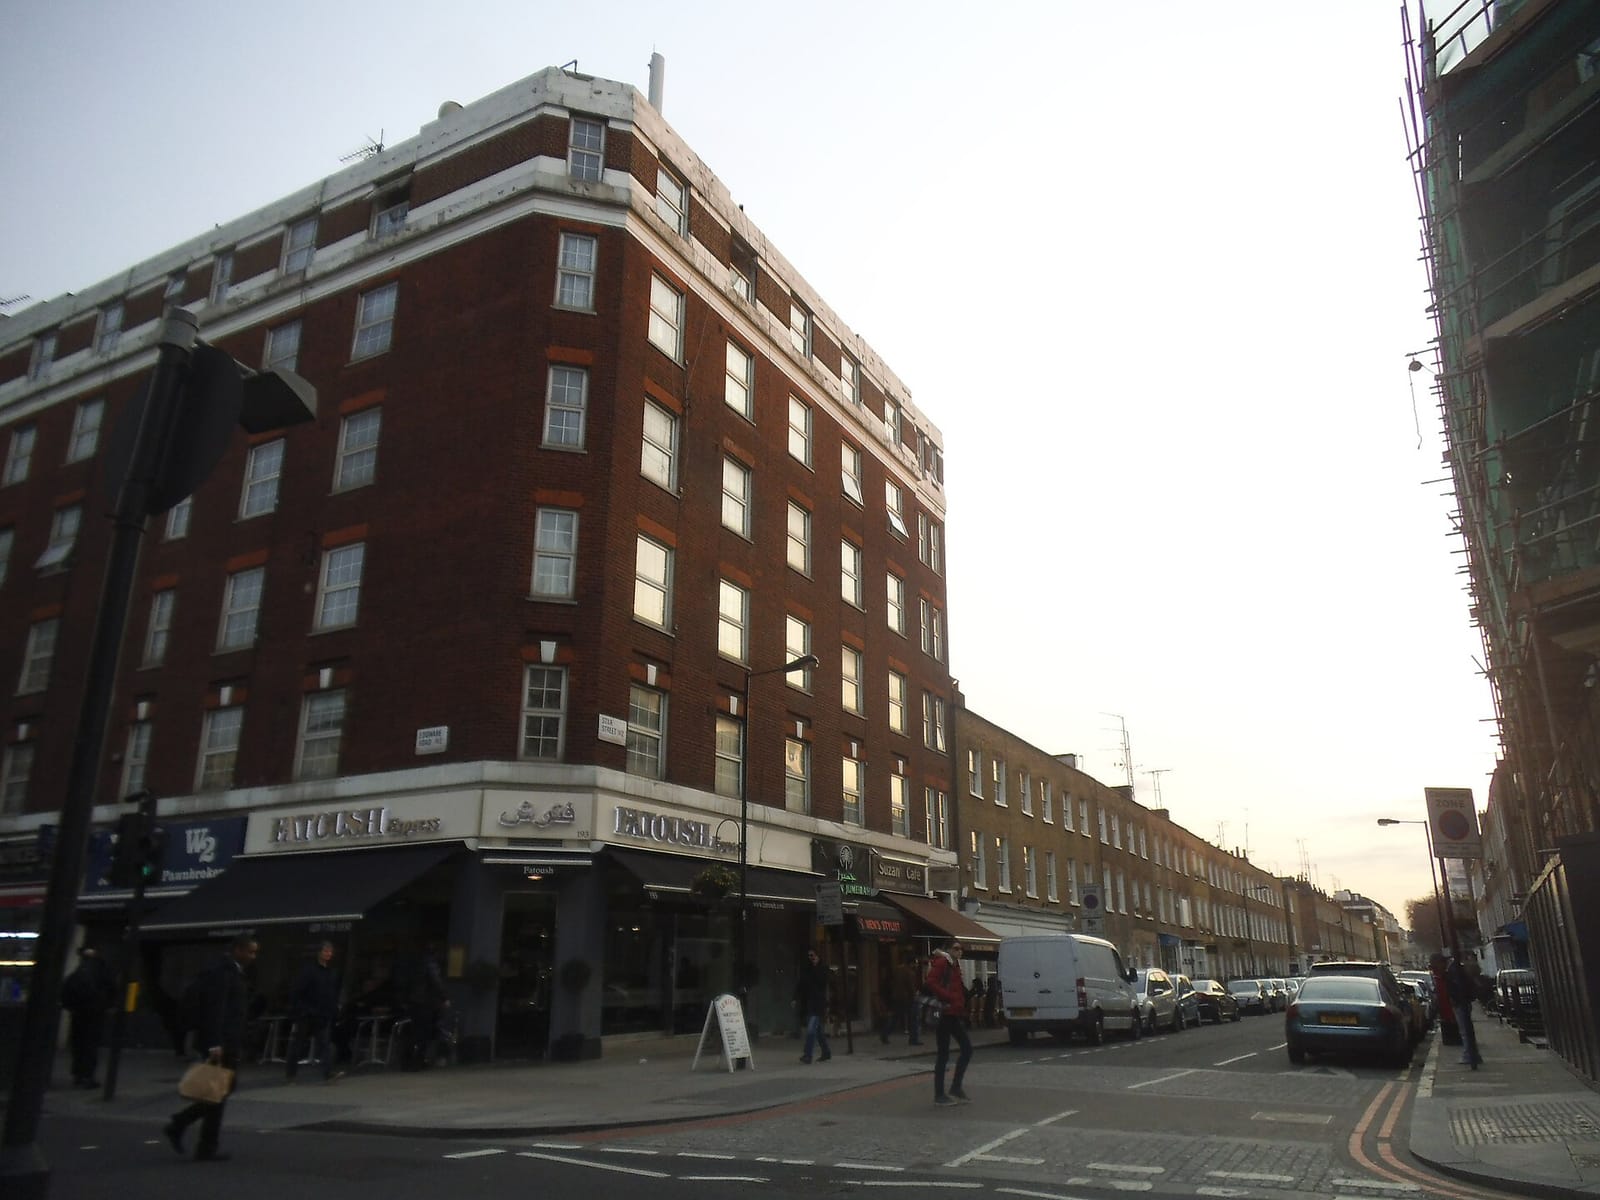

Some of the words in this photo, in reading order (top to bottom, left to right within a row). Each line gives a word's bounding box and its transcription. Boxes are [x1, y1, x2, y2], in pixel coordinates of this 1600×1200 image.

[601, 724, 617, 737] STREET
[1436, 800, 1465, 809] ZONE
[270, 808, 388, 843] FATOUSH
[613, 806, 717, 850] FATOUSH
[523, 865, 554, 875] Fatoush
[878, 863, 901, 878] Suzan
